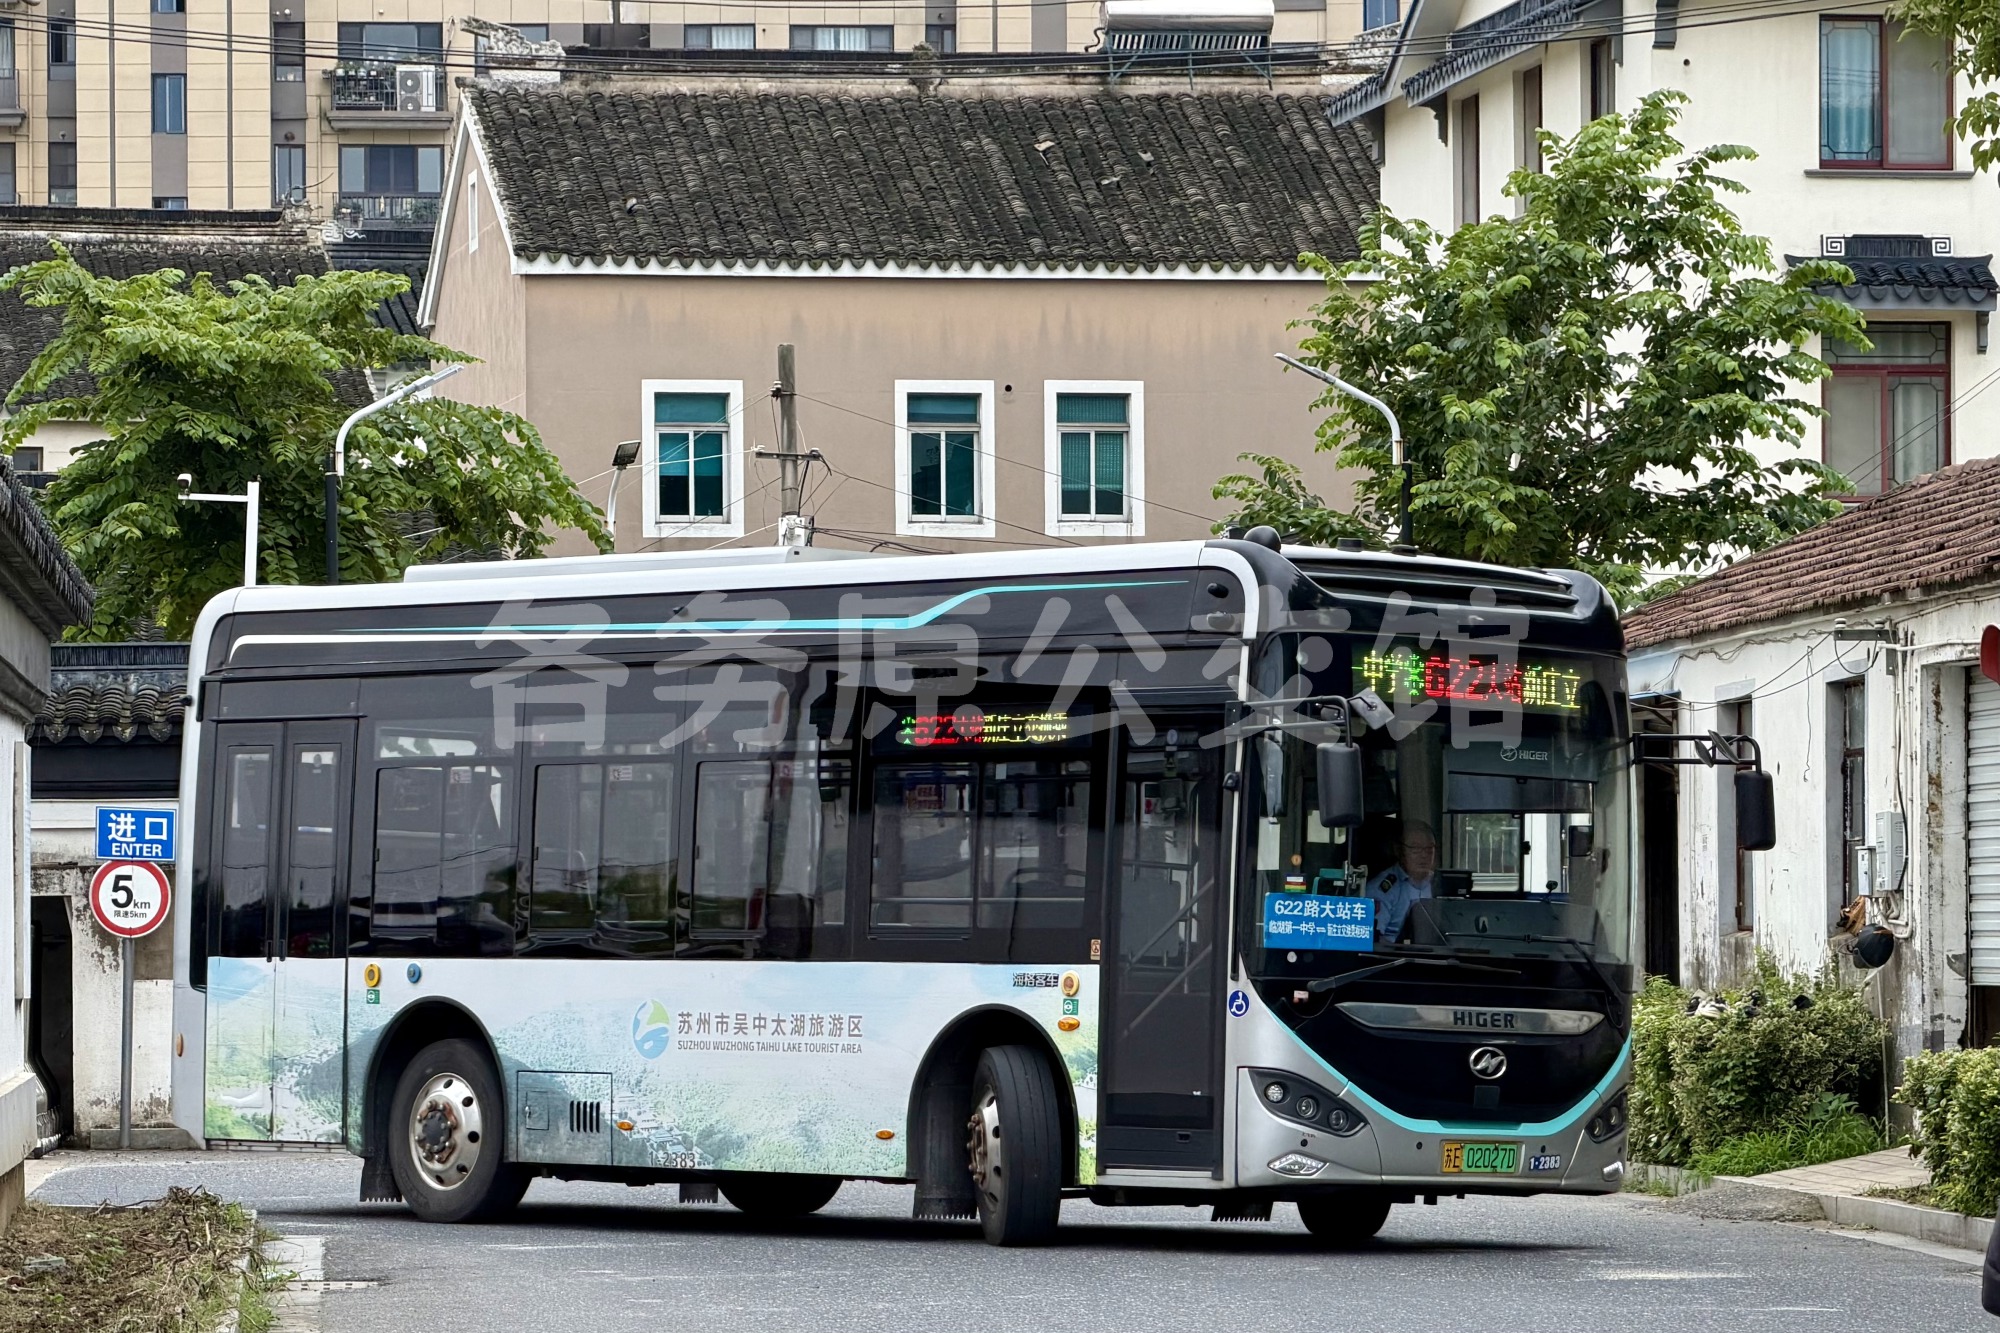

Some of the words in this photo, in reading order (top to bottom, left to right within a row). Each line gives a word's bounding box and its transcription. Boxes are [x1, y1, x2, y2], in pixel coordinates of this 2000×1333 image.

[1519, 751, 1548, 761] HIGER
[108, 812, 168, 842] 进口
[111, 843, 162, 857] ENTER
[1275, 900, 1367, 920] 622路大站车
[677, 1012, 863, 1038] 苏州市吴中太湖旅游区
[1453, 1011, 1515, 1028] HIGER
[678, 1040, 710, 1050] SUZHOU
[712, 1041, 754, 1051] WUZHONG
[756, 1042, 780, 1052] TAIHU
[782, 1042, 802, 1052] LAKE
[804, 1043, 839, 1053] TOURIST
[841, 1043, 862, 1054] AREA
